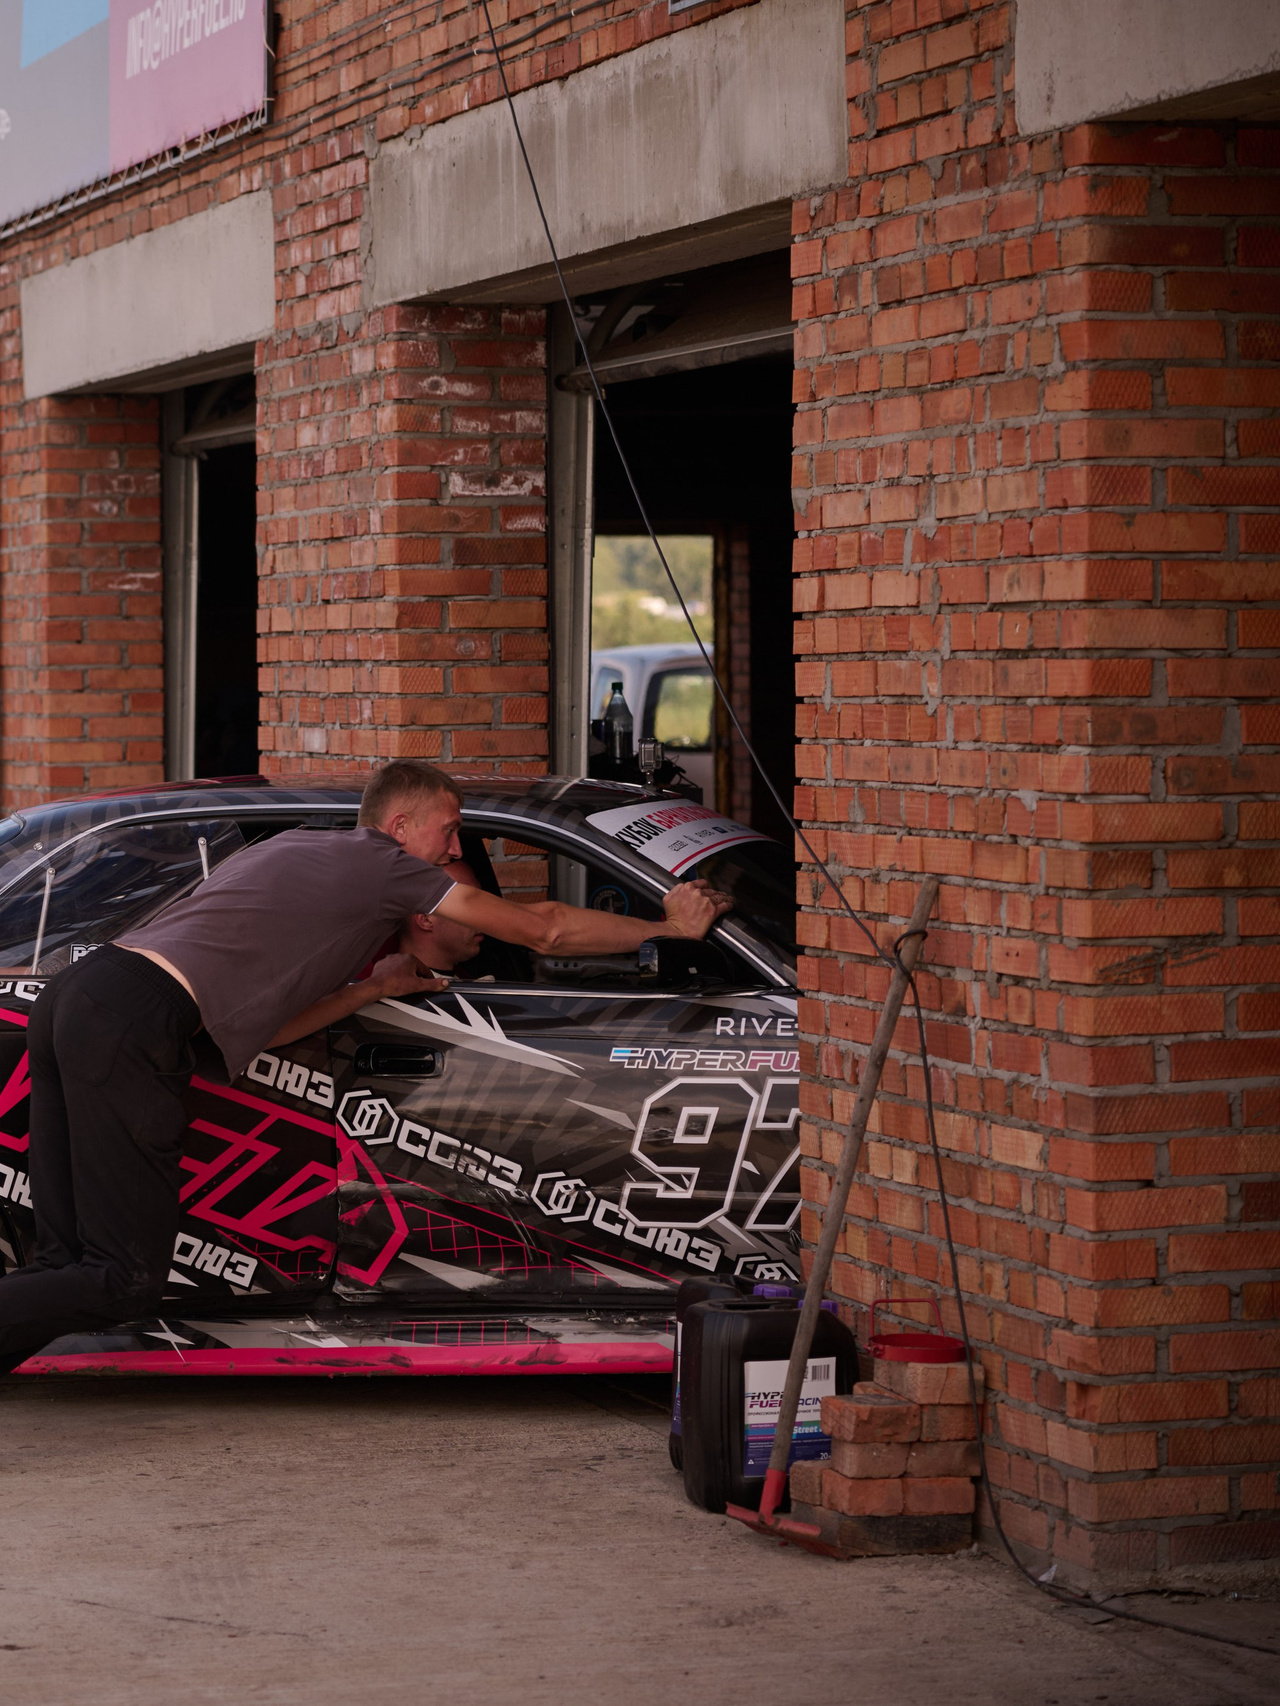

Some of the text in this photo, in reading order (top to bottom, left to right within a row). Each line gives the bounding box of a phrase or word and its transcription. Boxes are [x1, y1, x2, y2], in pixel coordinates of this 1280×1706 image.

[613, 817, 667, 849] КУБОК
[716, 1017, 798, 1037] RIVE
[611, 1048, 800, 1072] HYPERFU
[244, 1052, 336, 1109] ОЮЗ
[172, 1231, 259, 1289] ОЮЗ
